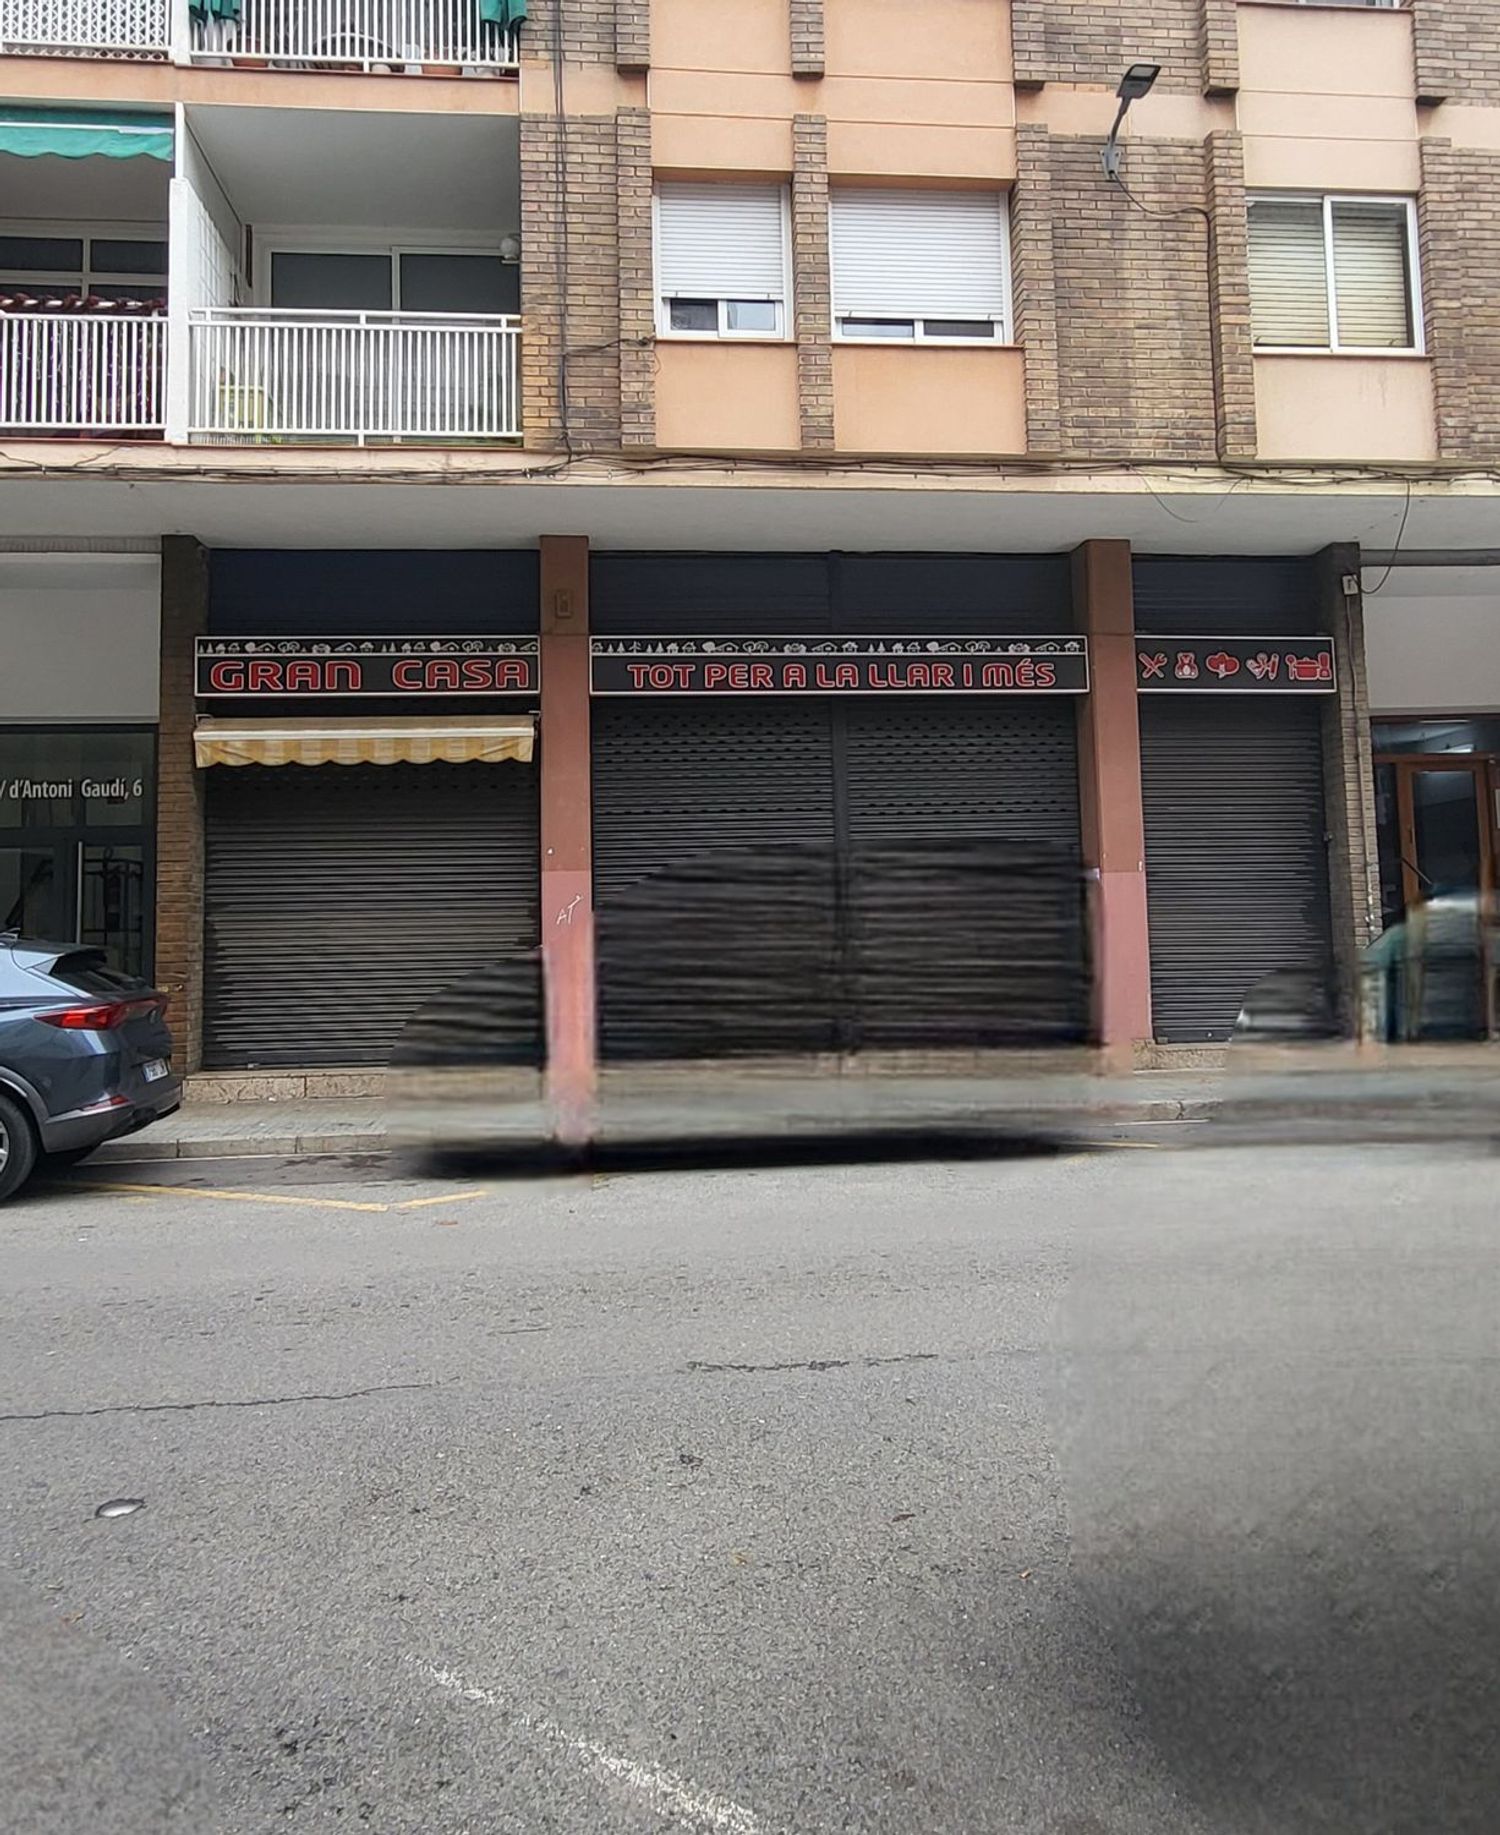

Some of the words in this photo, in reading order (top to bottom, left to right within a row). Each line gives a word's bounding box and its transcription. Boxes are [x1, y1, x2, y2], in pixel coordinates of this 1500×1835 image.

[210, 660, 361, 691] GRAN
[392, 659, 529, 690] CASA
[627, 664, 695, 689] TOT
[704, 663, 774, 689] PER
[782, 663, 807, 688] A
[816, 663, 859, 688] LA
[868, 663, 955, 688] LLAR
[963, 663, 973, 688] I
[982, 657, 1056, 687] MÉS
[9, 779, 72, 799] d'Antoni
[81, 778, 128, 800] Gaudí,
[133, 779, 142, 797] 6
